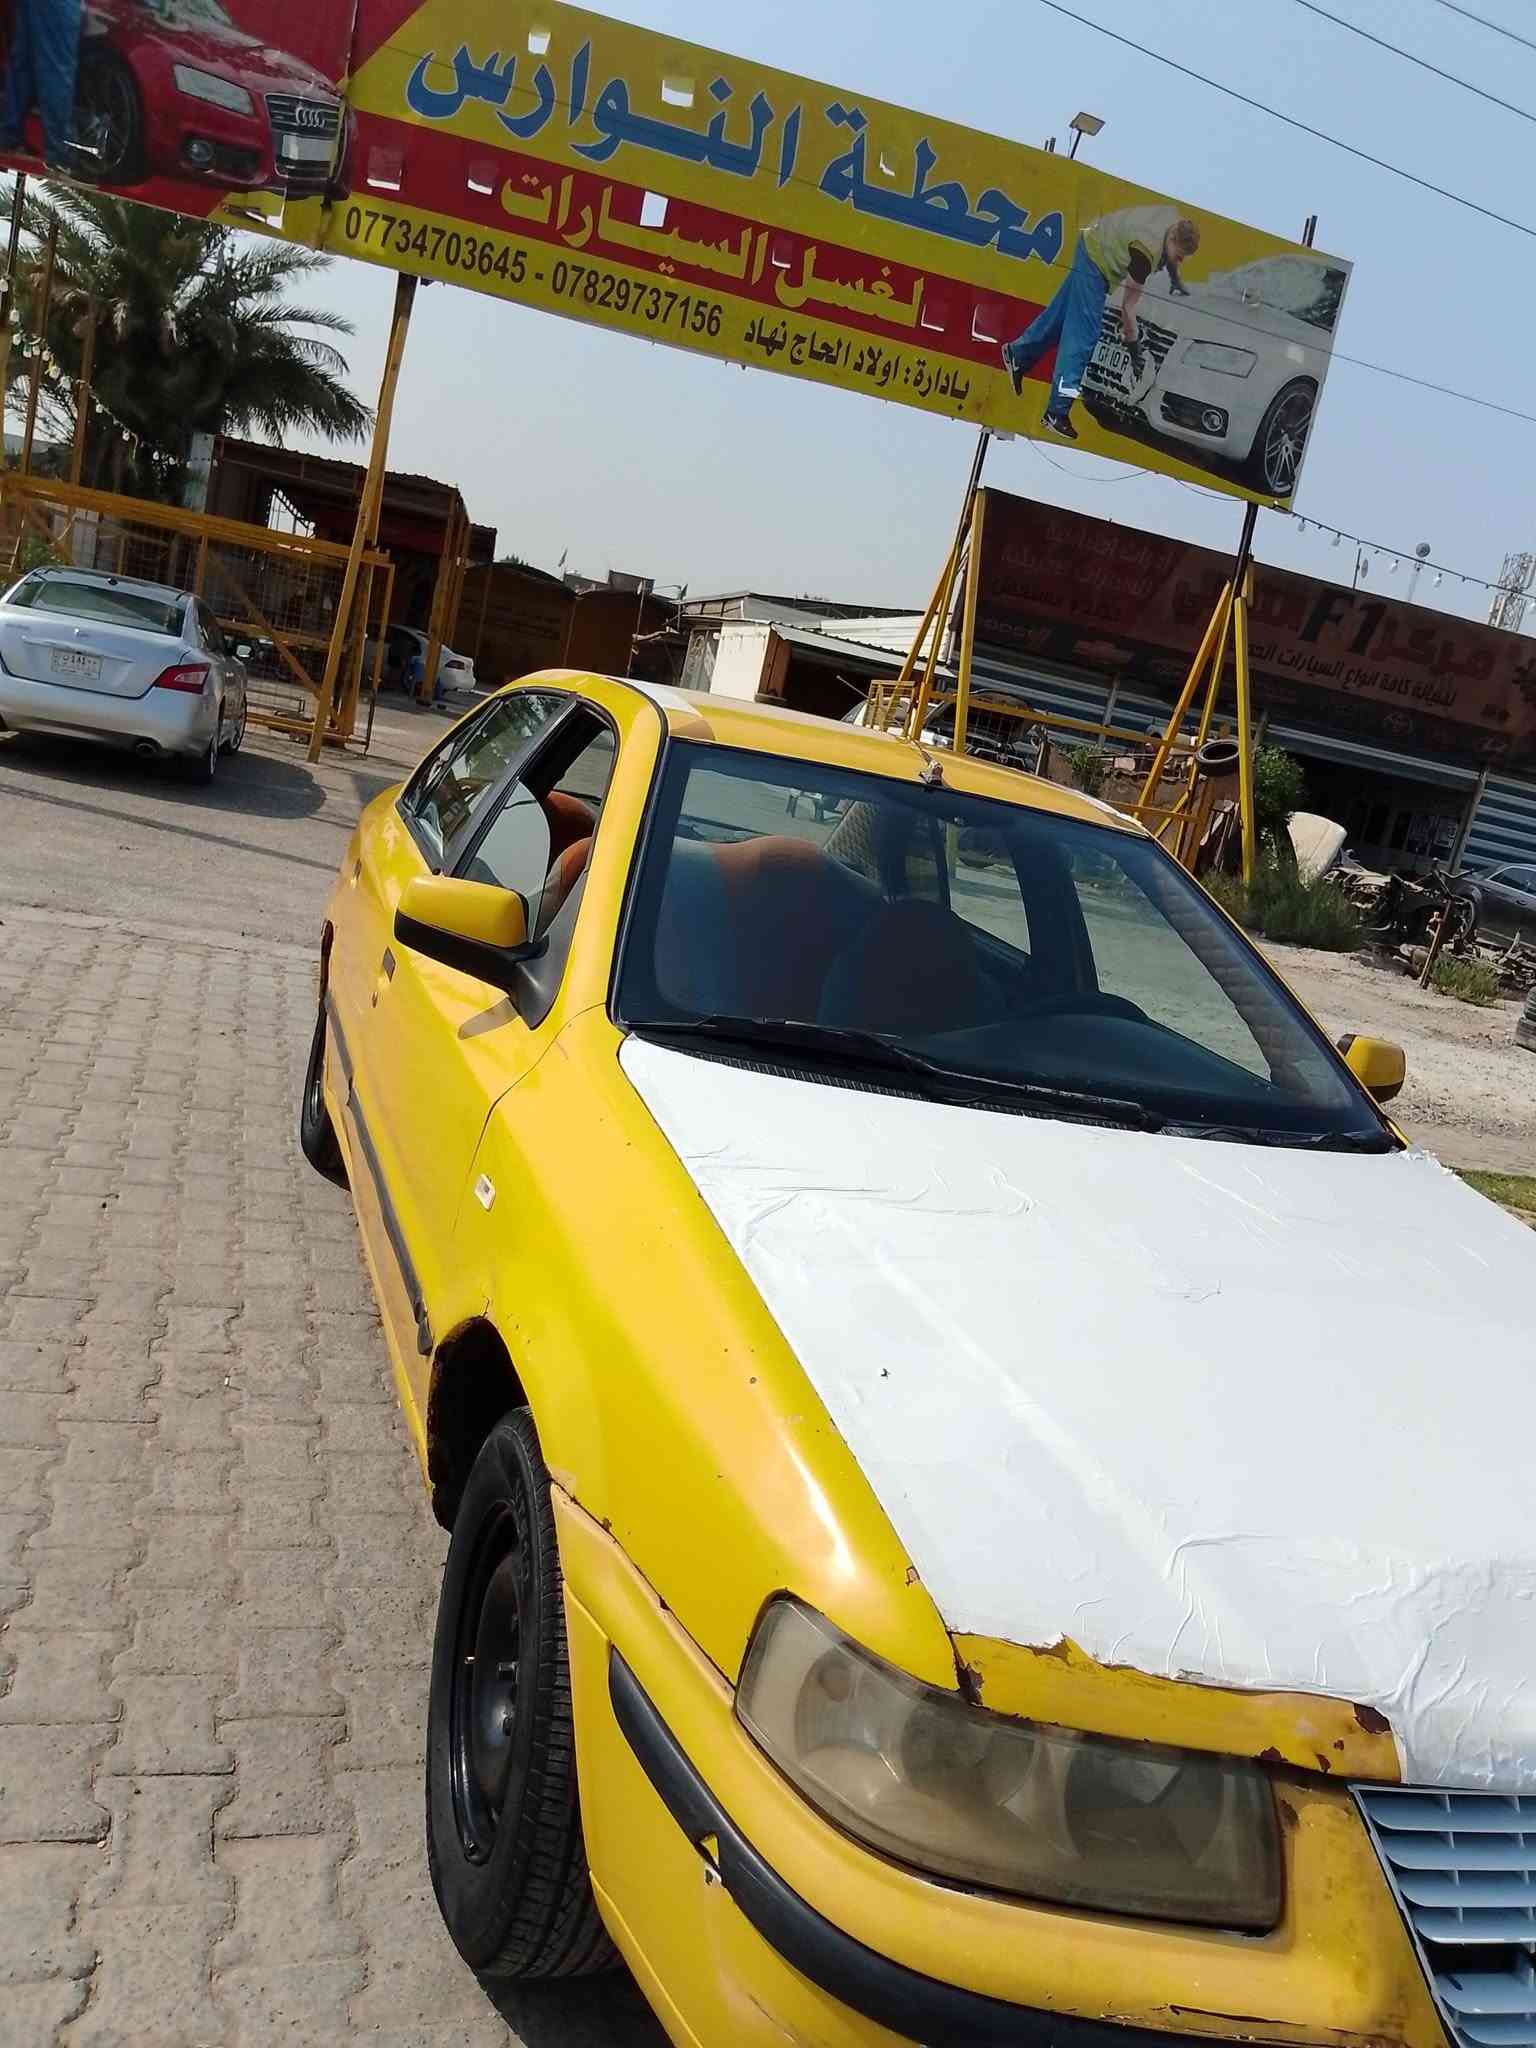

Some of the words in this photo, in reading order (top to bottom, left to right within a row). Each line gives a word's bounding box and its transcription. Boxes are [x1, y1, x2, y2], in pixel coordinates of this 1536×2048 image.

[405, 40, 801, 189] النوارس
[819, 101, 1064, 266] محطة
[500, 172, 768, 286] السيارات
[345, 206, 527, 284] 07734703645
[551, 260, 722, 338] 07829737156
[775, 246, 925, 328] لغسل
[744, 315, 788, 358] نهاد
[789, 332, 851, 367] الحاج
[853, 347, 900, 387] اولاد
[1299, 587, 1387, 656] F1
[1277, 651, 1345, 680] السيارات
